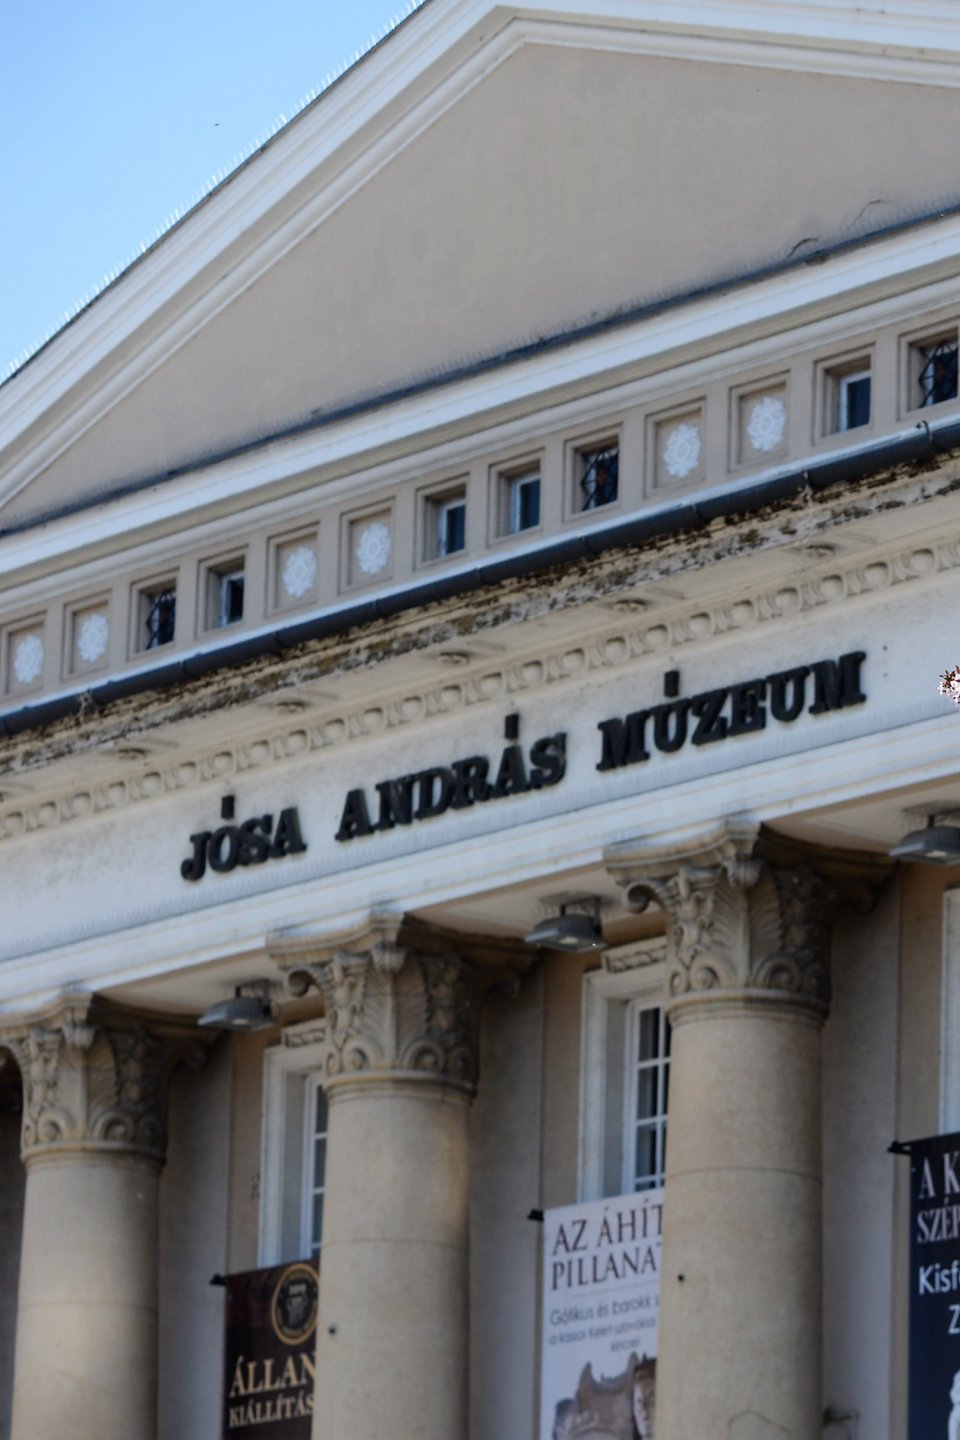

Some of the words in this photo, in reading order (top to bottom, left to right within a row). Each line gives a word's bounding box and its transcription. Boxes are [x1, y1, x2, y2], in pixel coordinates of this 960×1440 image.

[181, 794, 308, 883] JÓSA
[335, 713, 567, 842] ANDRÁS
[596, 652, 867, 772] MÚZEUM
[918, 1156, 936, 1199] A
[552, 1219, 588, 1256] AZ
[597, 1198, 663, 1248] ÁHÍT
[552, 1242, 662, 1290] PILLANA
[229, 1352, 316, 1398] ÁLLAN
